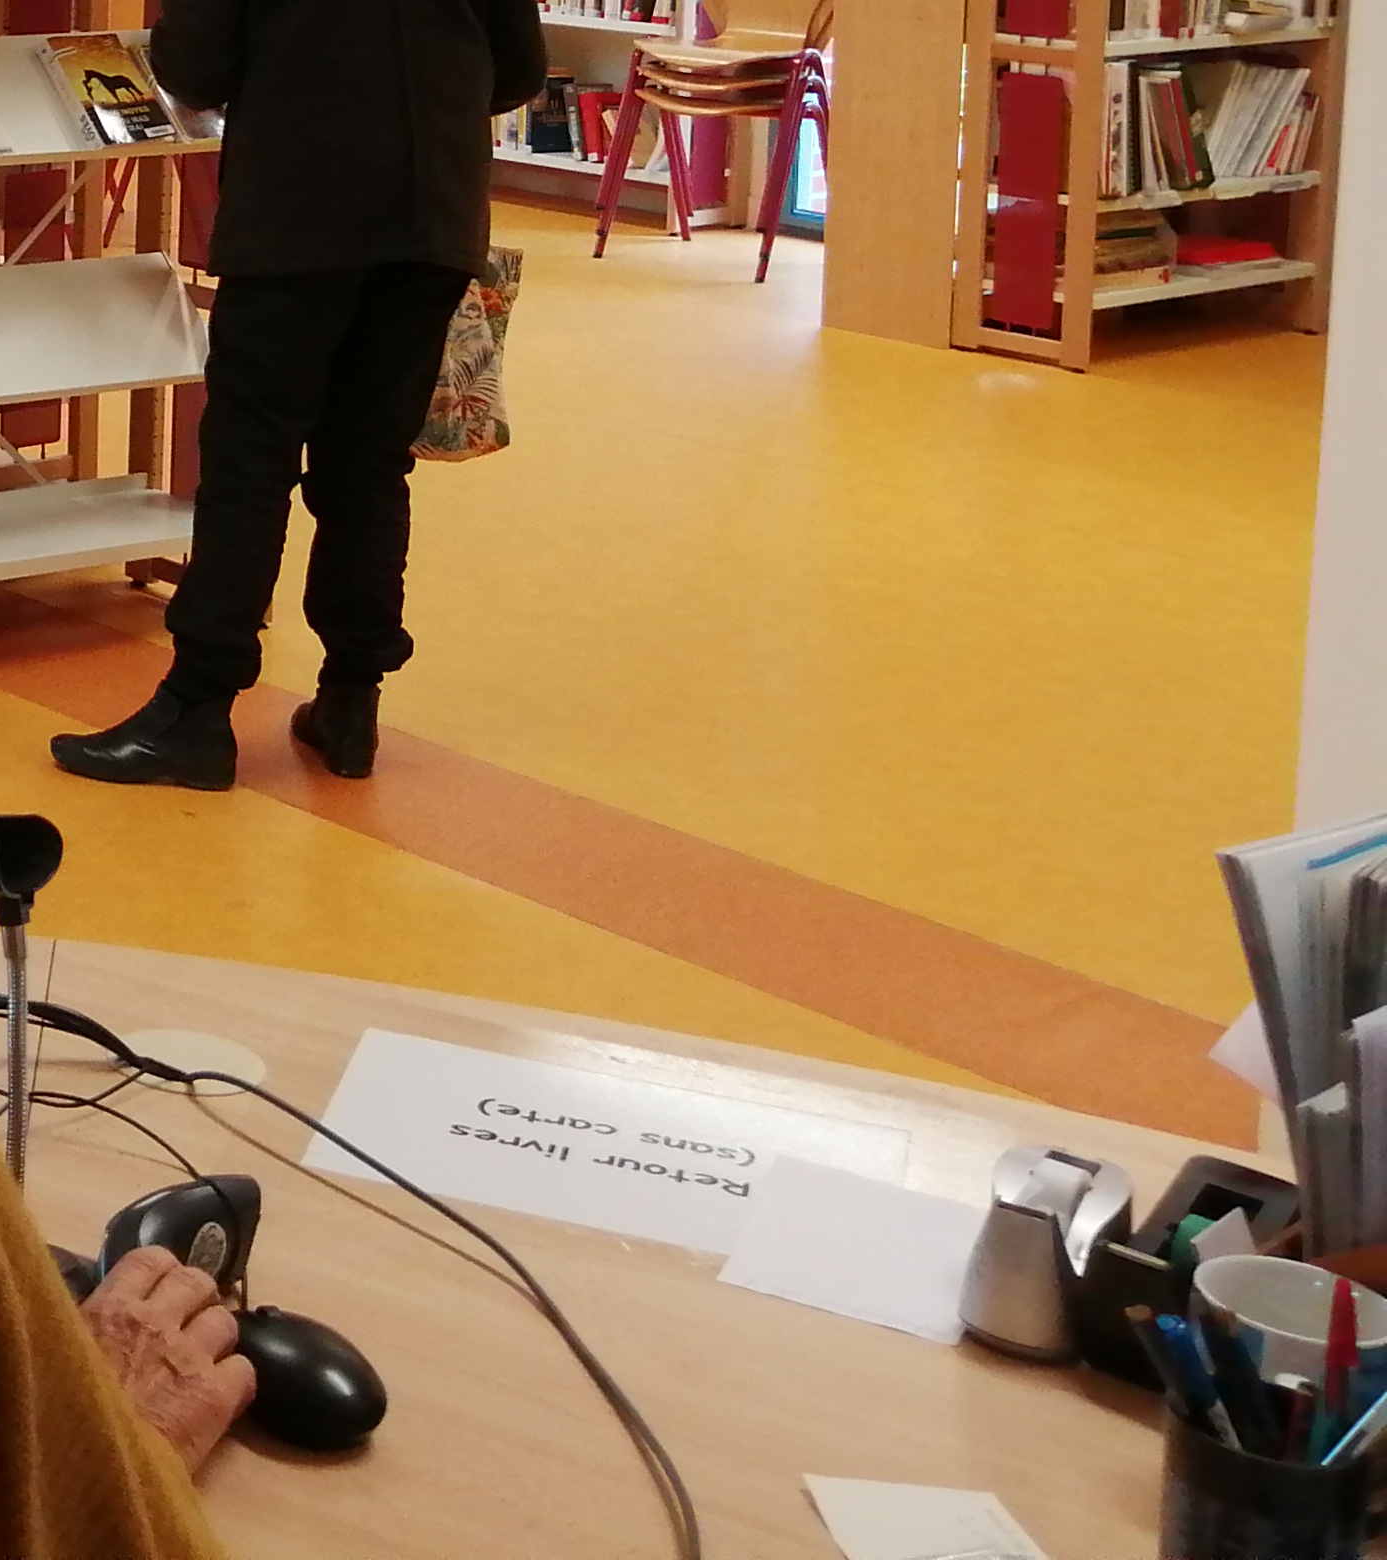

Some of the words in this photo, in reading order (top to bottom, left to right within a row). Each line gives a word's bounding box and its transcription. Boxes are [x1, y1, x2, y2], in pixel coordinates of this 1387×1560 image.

[476, 1098, 618, 1135] carte)
[449, 1122, 570, 1162] livres
[639, 1131, 756, 1167] (sans
[593, 1154, 751, 1198] Retour
